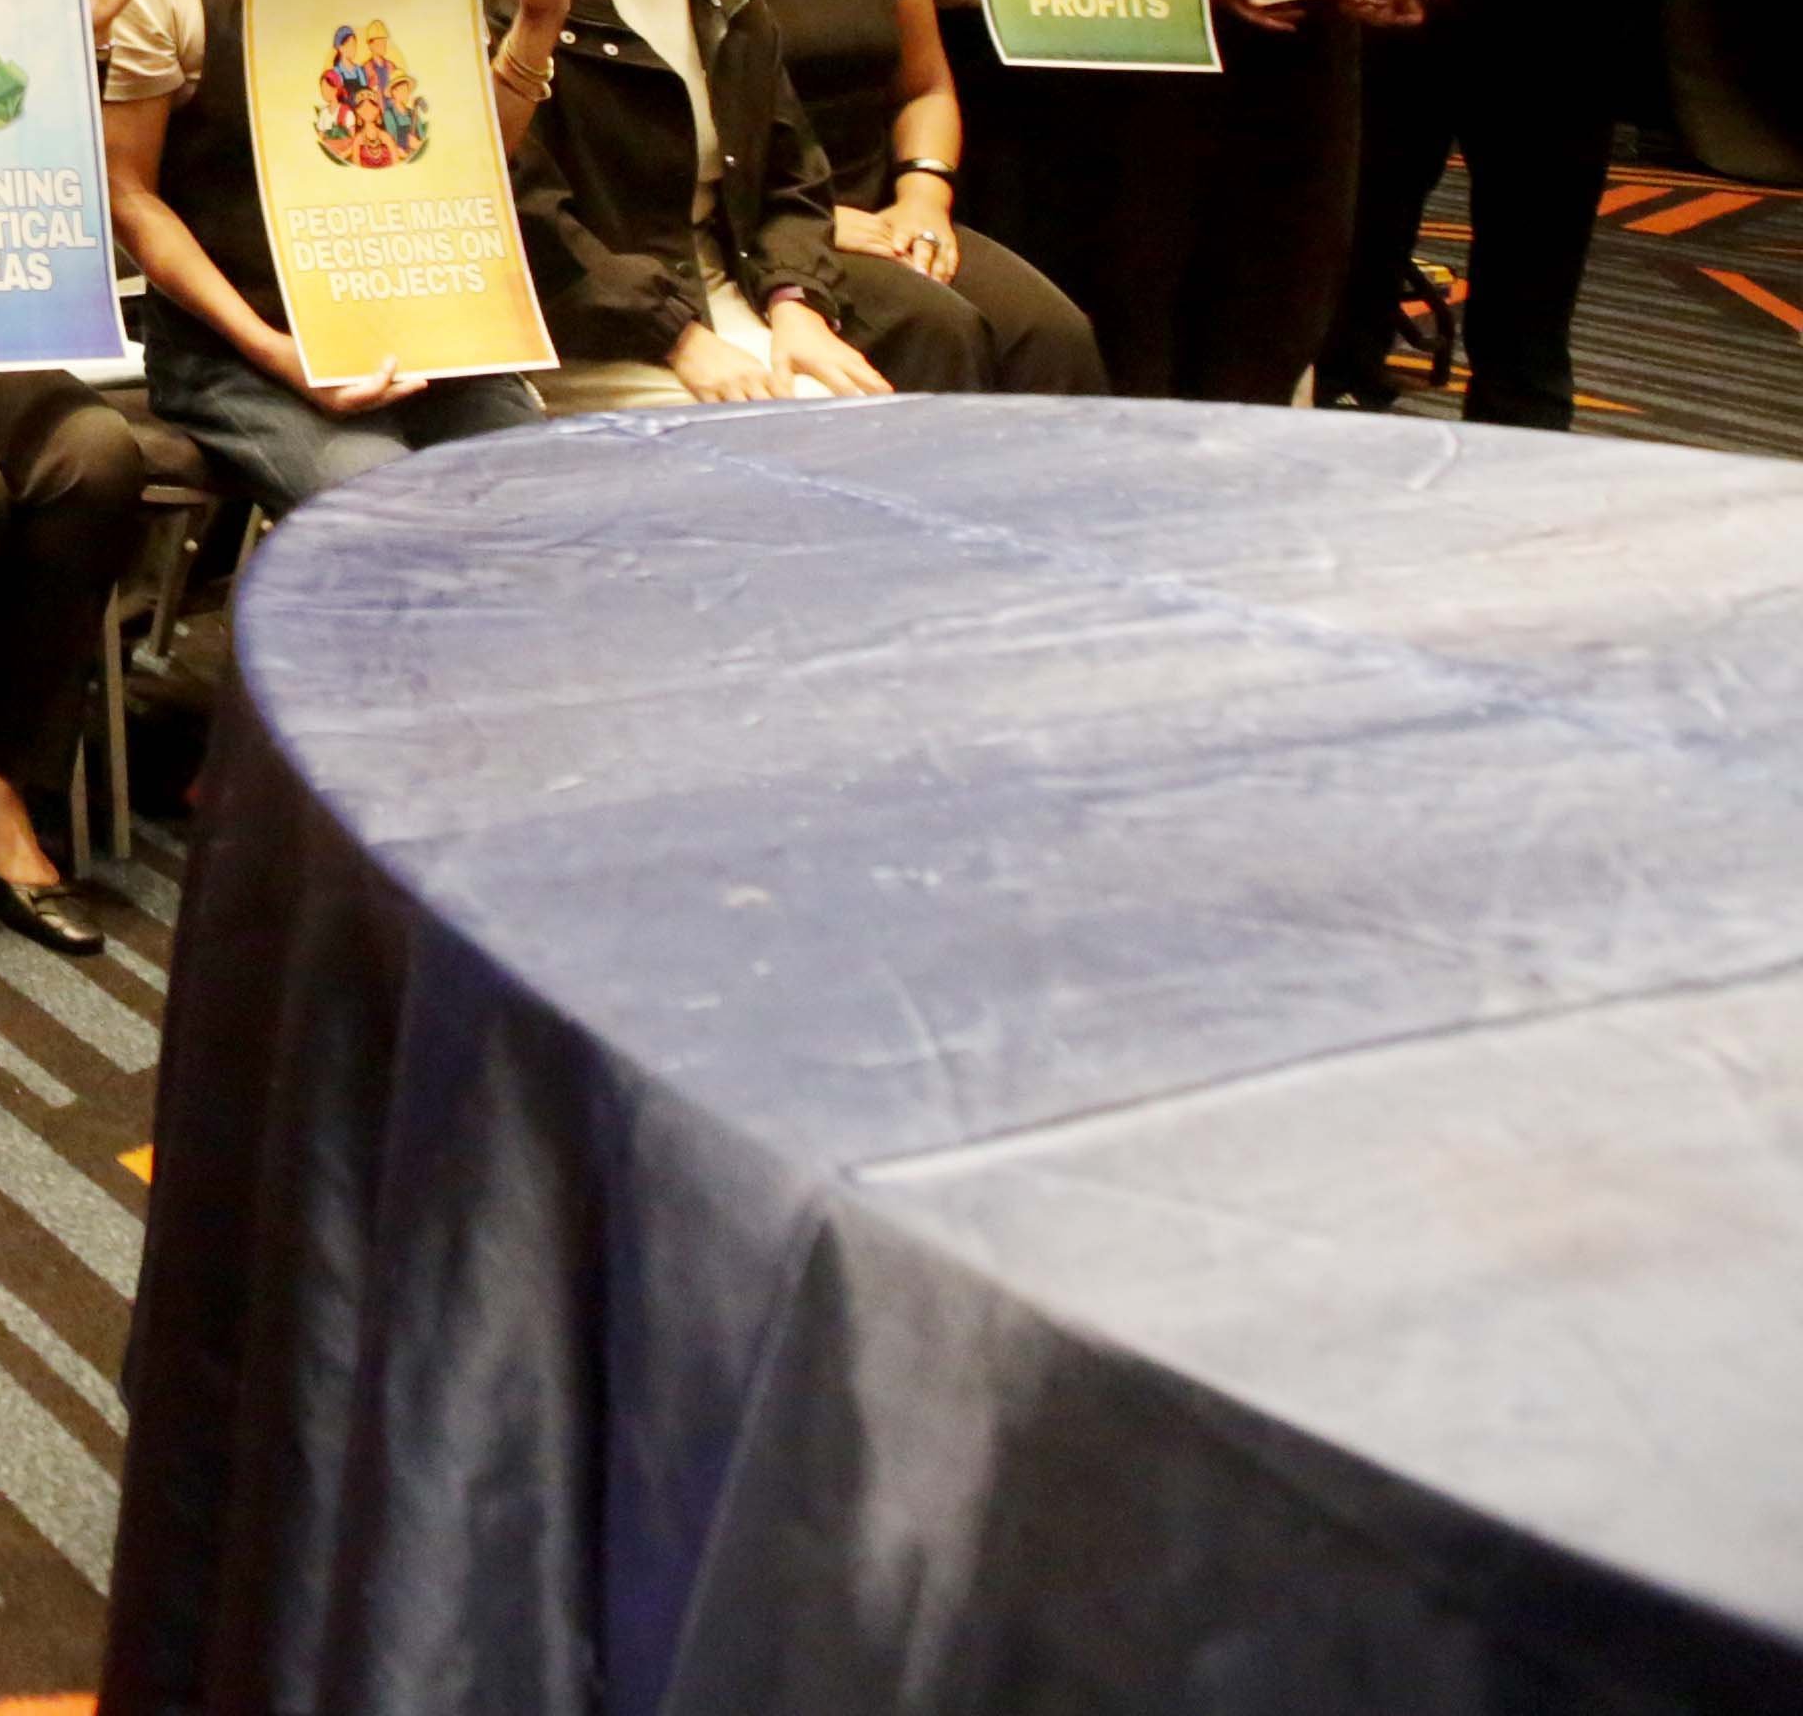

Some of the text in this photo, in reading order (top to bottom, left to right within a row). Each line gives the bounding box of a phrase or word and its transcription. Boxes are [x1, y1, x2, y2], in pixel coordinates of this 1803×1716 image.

[285, 196, 498, 240] PEOPLE MAKE
[293, 228, 506, 274] DECISIONS ON
[329, 264, 486, 304] PROJECTS
